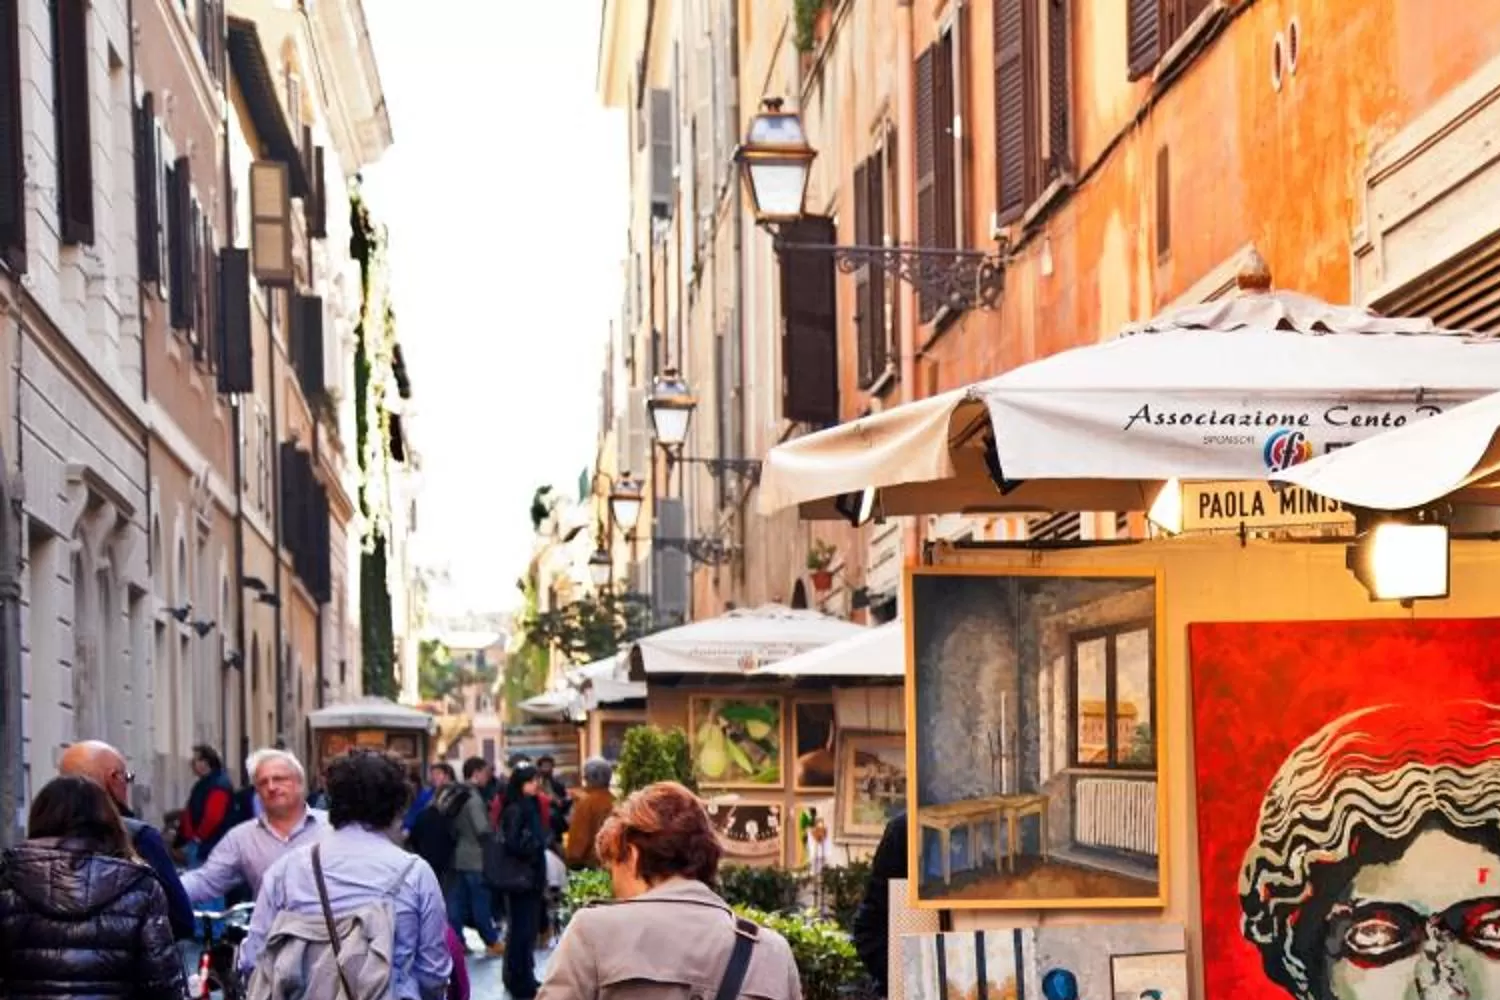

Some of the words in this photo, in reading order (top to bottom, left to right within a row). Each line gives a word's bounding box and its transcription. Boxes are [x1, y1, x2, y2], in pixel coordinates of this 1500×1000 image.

[1124, 403, 1310, 430] Associazione
[1324, 405, 1407, 427] Cento
[1199, 490, 1265, 519] PAOLA
